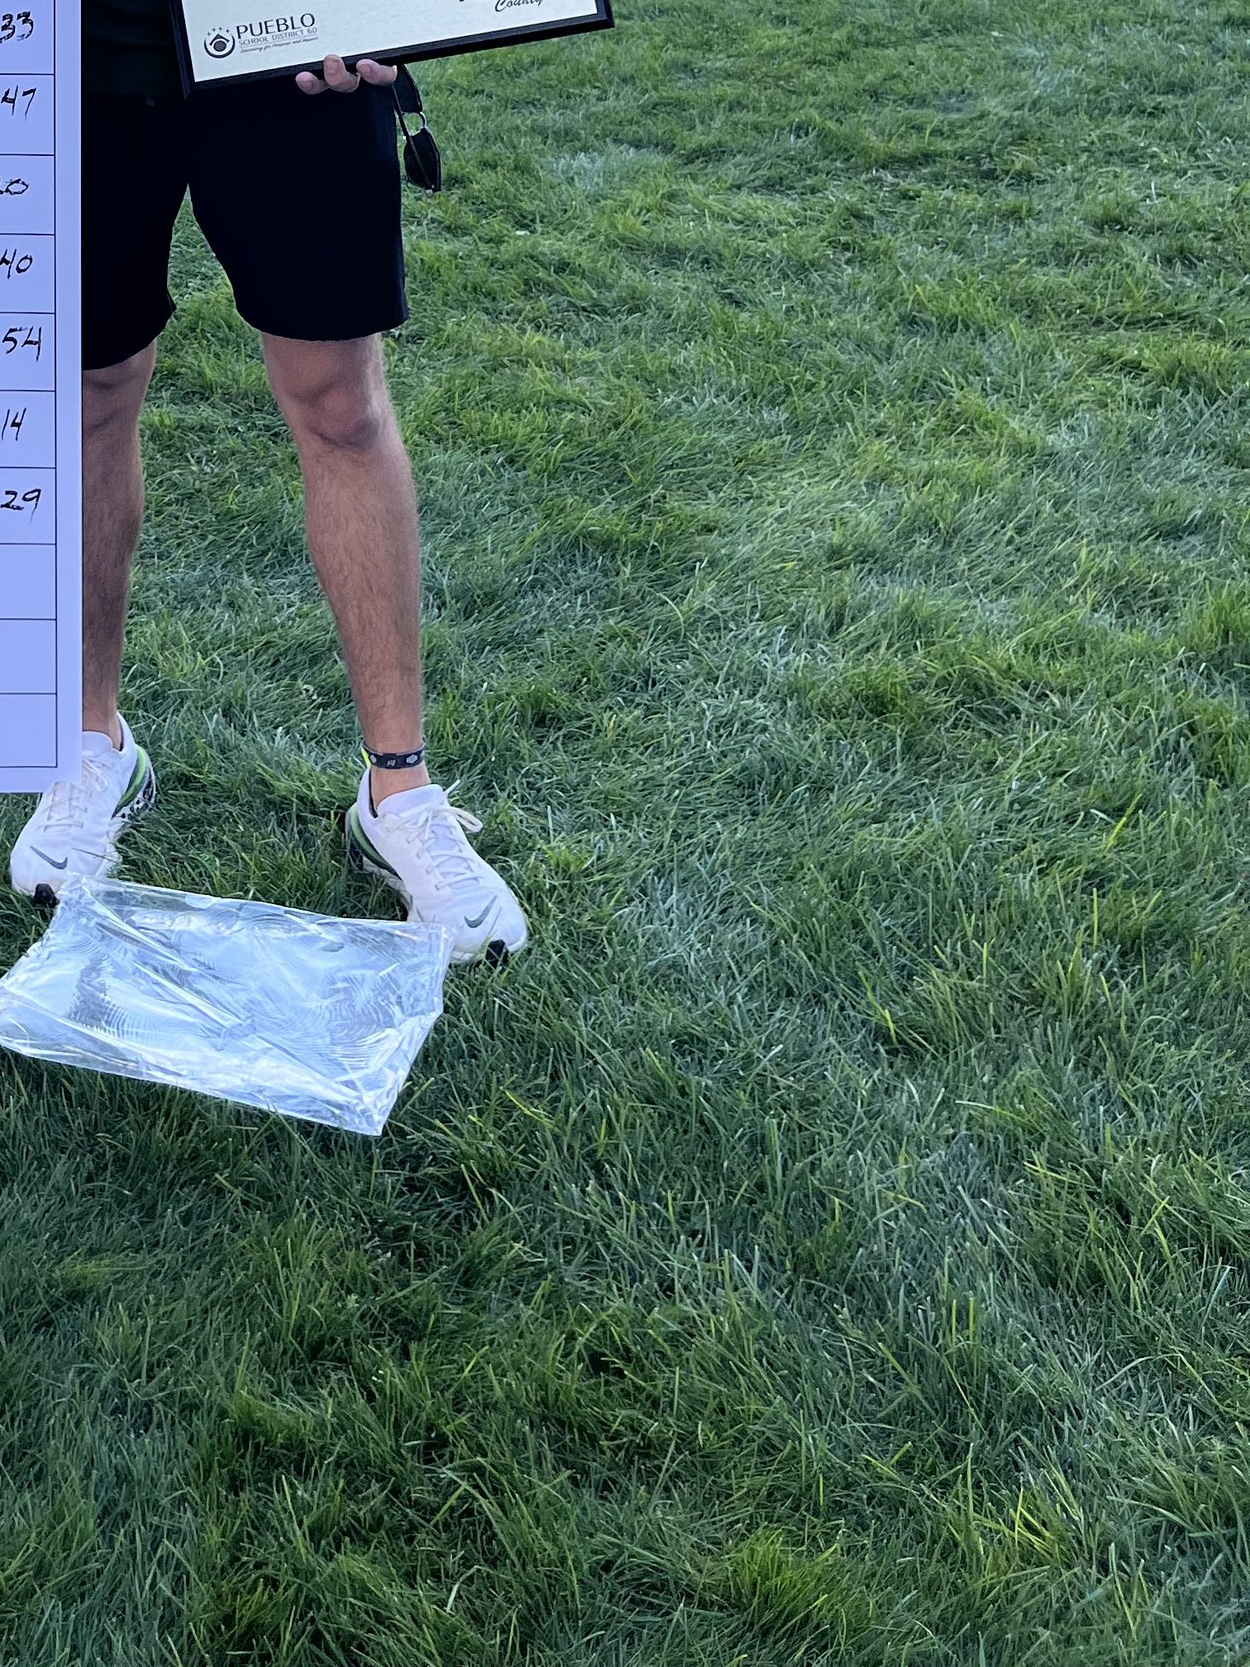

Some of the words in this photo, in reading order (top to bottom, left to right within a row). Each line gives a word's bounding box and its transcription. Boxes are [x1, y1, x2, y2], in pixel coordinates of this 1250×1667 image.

[236, 13, 316, 40] PUEBLO
[238, 37, 268, 47] SCHOOL
[272, 30, 304, 41] DISTRICT
